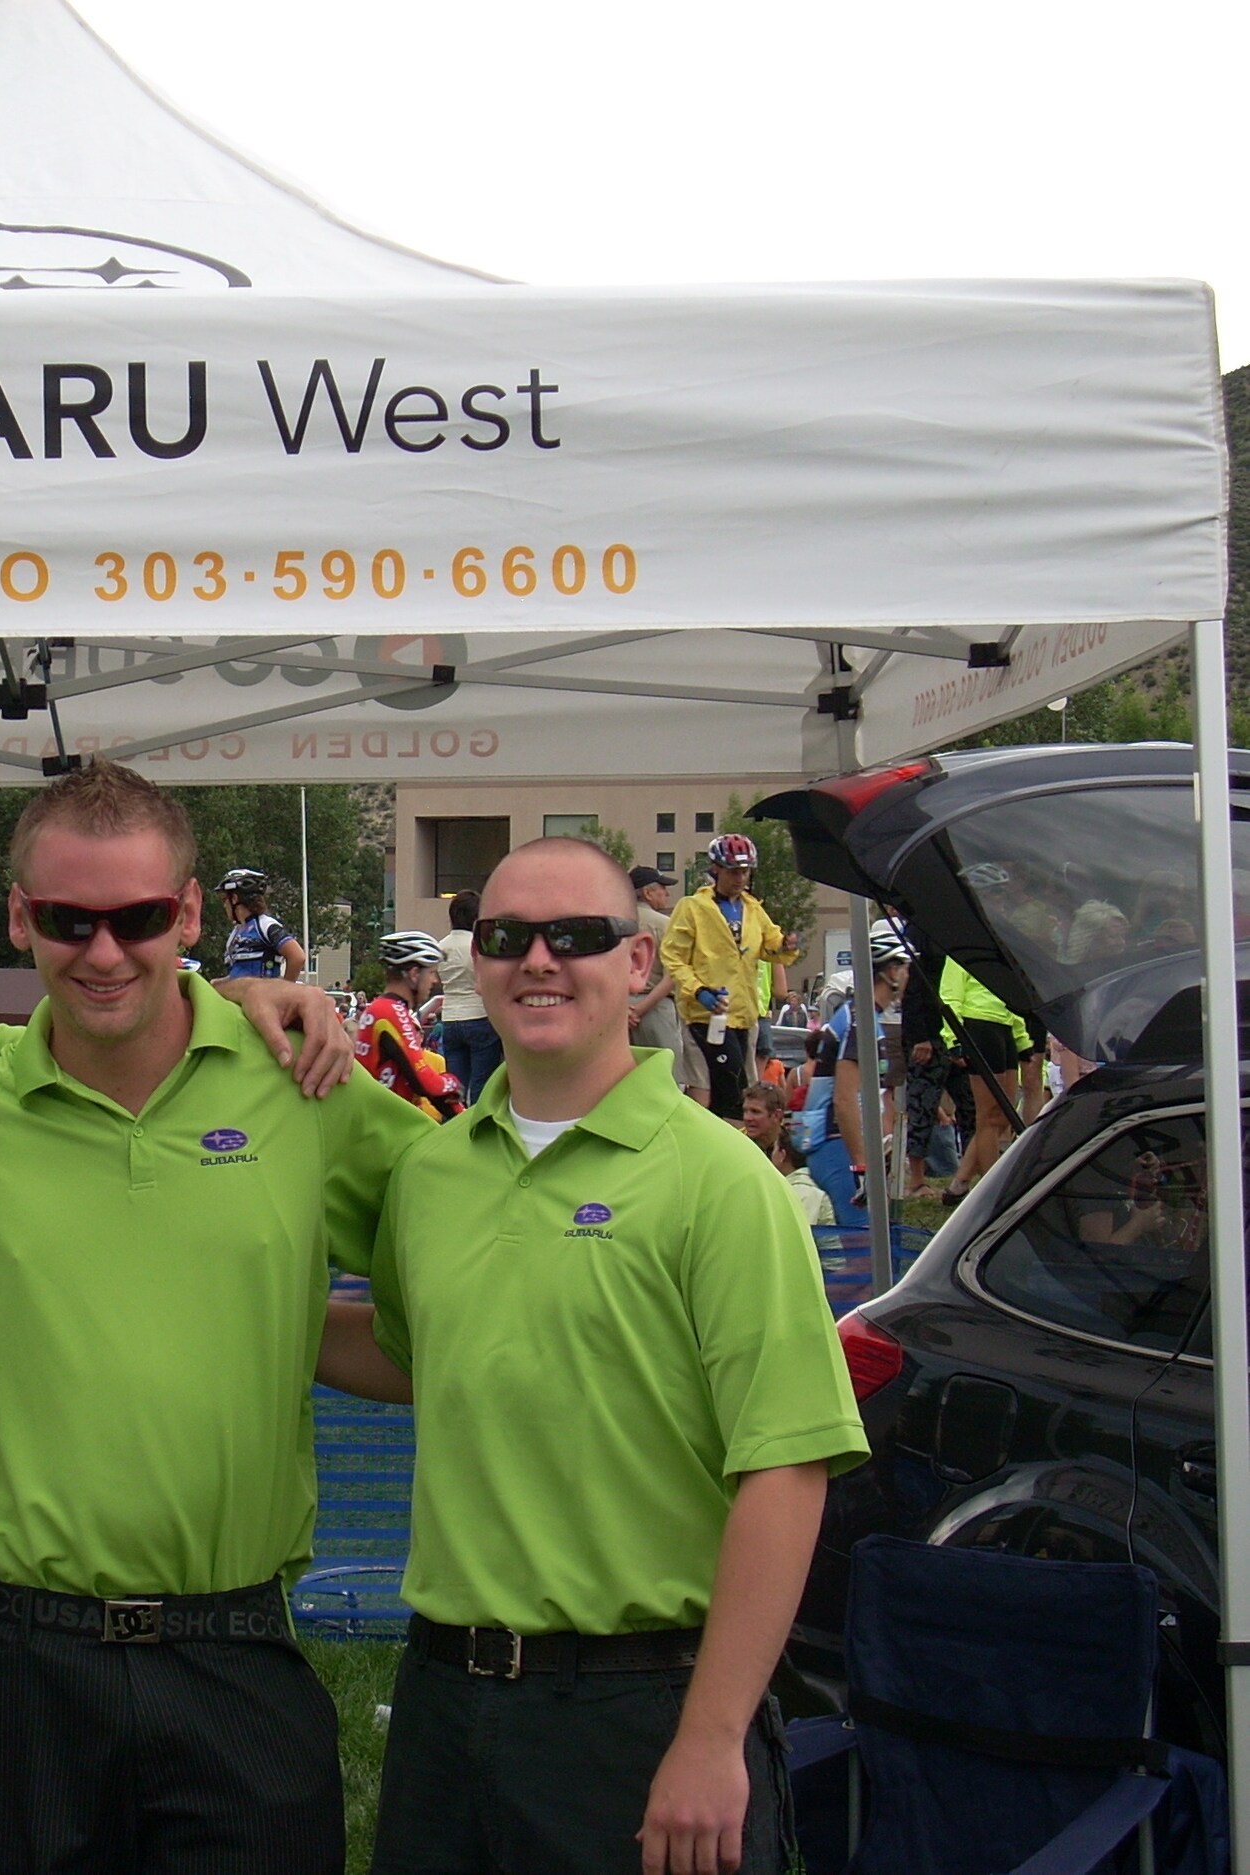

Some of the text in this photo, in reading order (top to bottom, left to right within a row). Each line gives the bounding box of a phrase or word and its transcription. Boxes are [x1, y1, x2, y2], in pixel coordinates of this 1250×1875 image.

[256, 357, 562, 456] West
[200, 1154, 257, 1167] SUBARU
[563, 1228, 612, 1240] SUBARU
